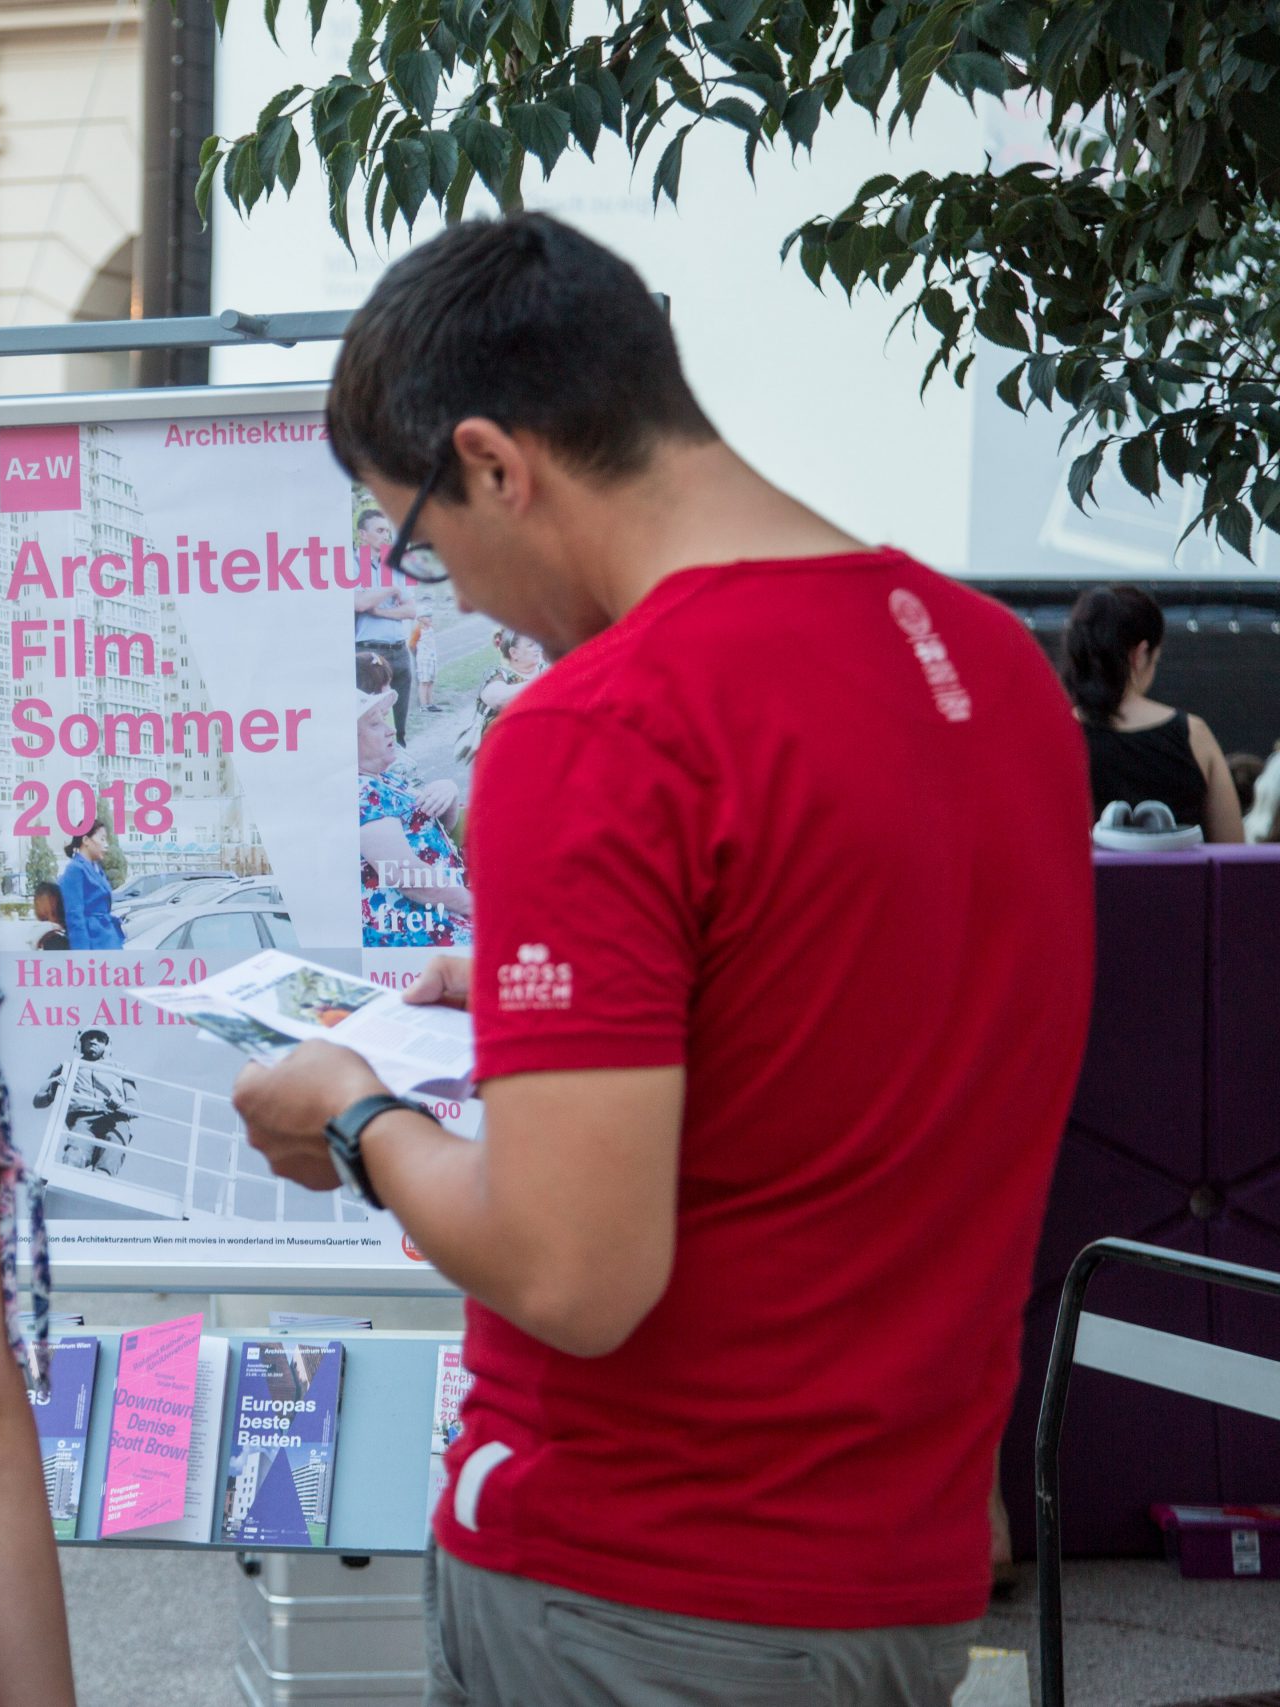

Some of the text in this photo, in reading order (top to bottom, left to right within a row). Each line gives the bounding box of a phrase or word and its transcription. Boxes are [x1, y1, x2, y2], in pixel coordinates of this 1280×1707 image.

[11, 618, 175, 679] Film.
[11, 698, 311, 759] Sommer
[12, 778, 175, 838] 2018
[375, 902, 446, 932] frei!
[16, 958, 146, 987] Habitat
[158, 957, 208, 986] 2.0
[16, 998, 81, 1026] Aus
[91, 998, 144, 1026] Alt
[61, 1235, 76, 1243] des
[77, 1235, 152, 1244] Architekturzentrum
[153, 1236, 173, 1244] Wien
[189, 1237, 217, 1245] movies
[218, 1237, 226, 1245] in
[227, 1237, 273, 1245] wonderland
[275, 1237, 285, 1245] im
[286, 1237, 359, 1246] MuseumsQuartier
[360, 1238, 382, 1246] Wien
[116, 1388, 194, 1418] Downtown
[241, 1395, 316, 1416] Europas
[127, 1412, 176, 1437] Denise
[240, 1413, 290, 1430] beste
[110, 1429, 145, 1452] Scott
[237, 1430, 302, 1448] Bauten
